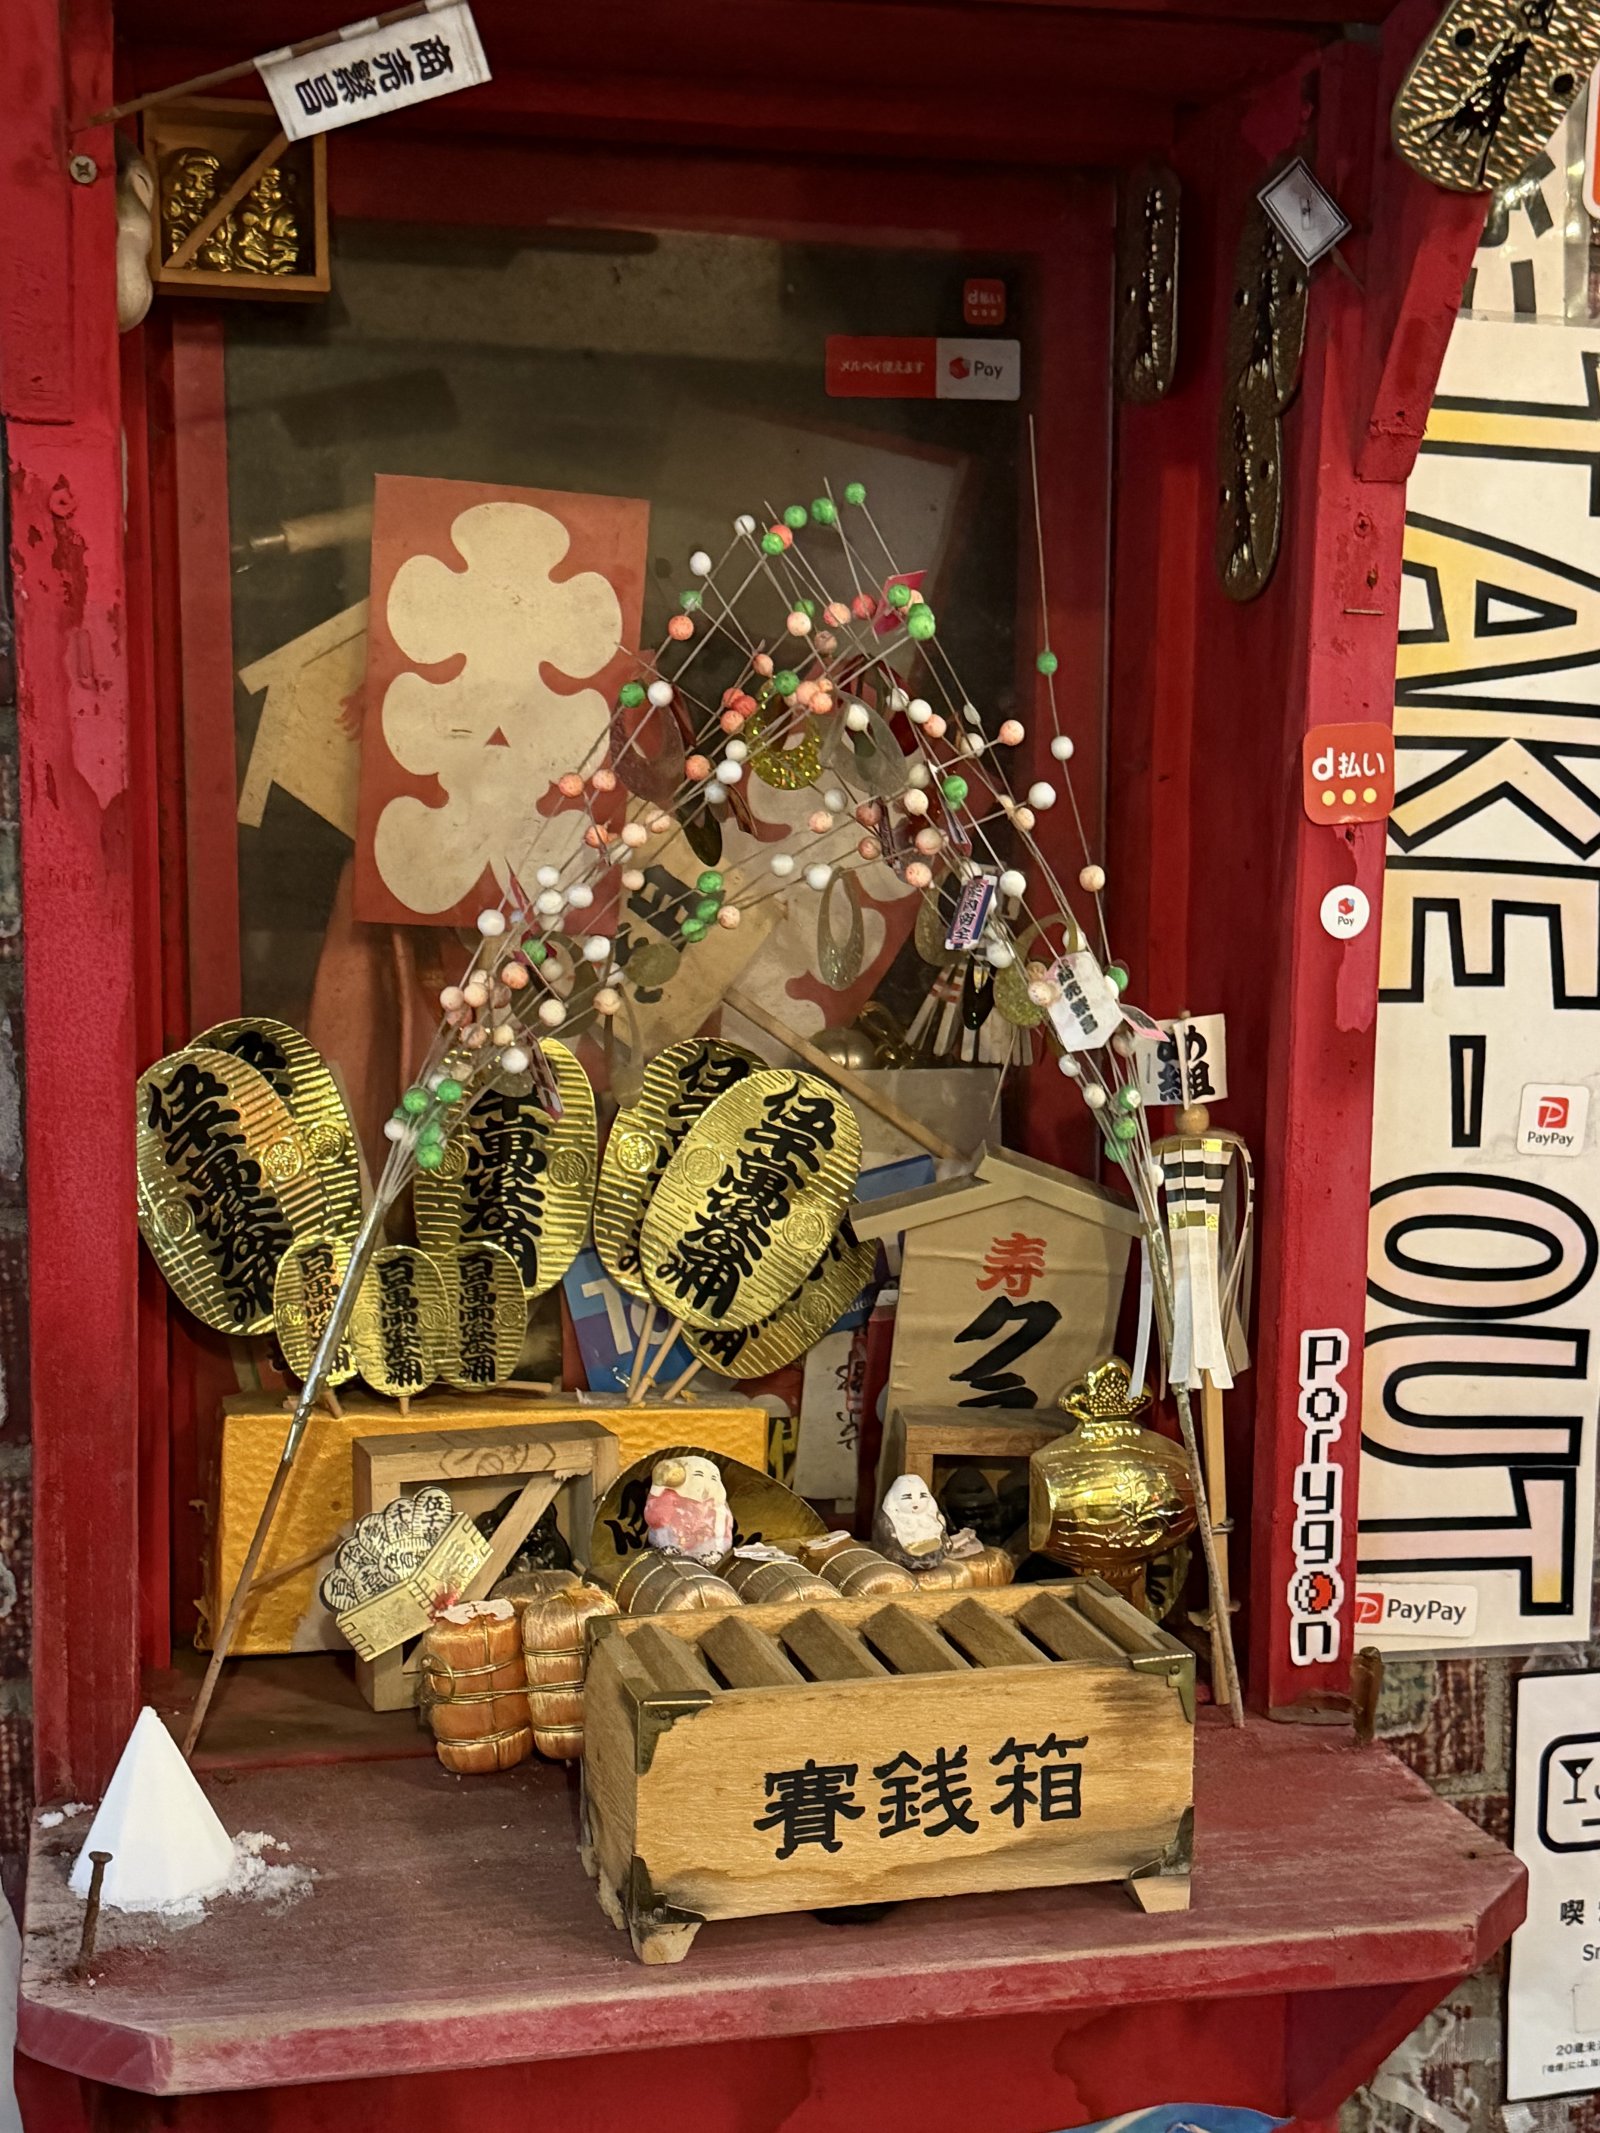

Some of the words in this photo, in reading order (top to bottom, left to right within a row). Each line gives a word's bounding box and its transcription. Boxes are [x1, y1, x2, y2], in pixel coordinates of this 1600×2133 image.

[295, 35, 455, 115] 商売繁昌
[974, 361, 1003, 379] Pay
[1312, 747, 1385, 781] d払い
[1338, 916, 1354, 926] Pay
[1527, 1131, 1574, 1147] PayPay
[975, 1232, 1047, 1297] 寿
[1387, 1599, 1466, 1625] PayPay
[753, 1732, 1089, 1860] 賽銭箱
[1556, 2040, 1600, 2056] 20歳未
